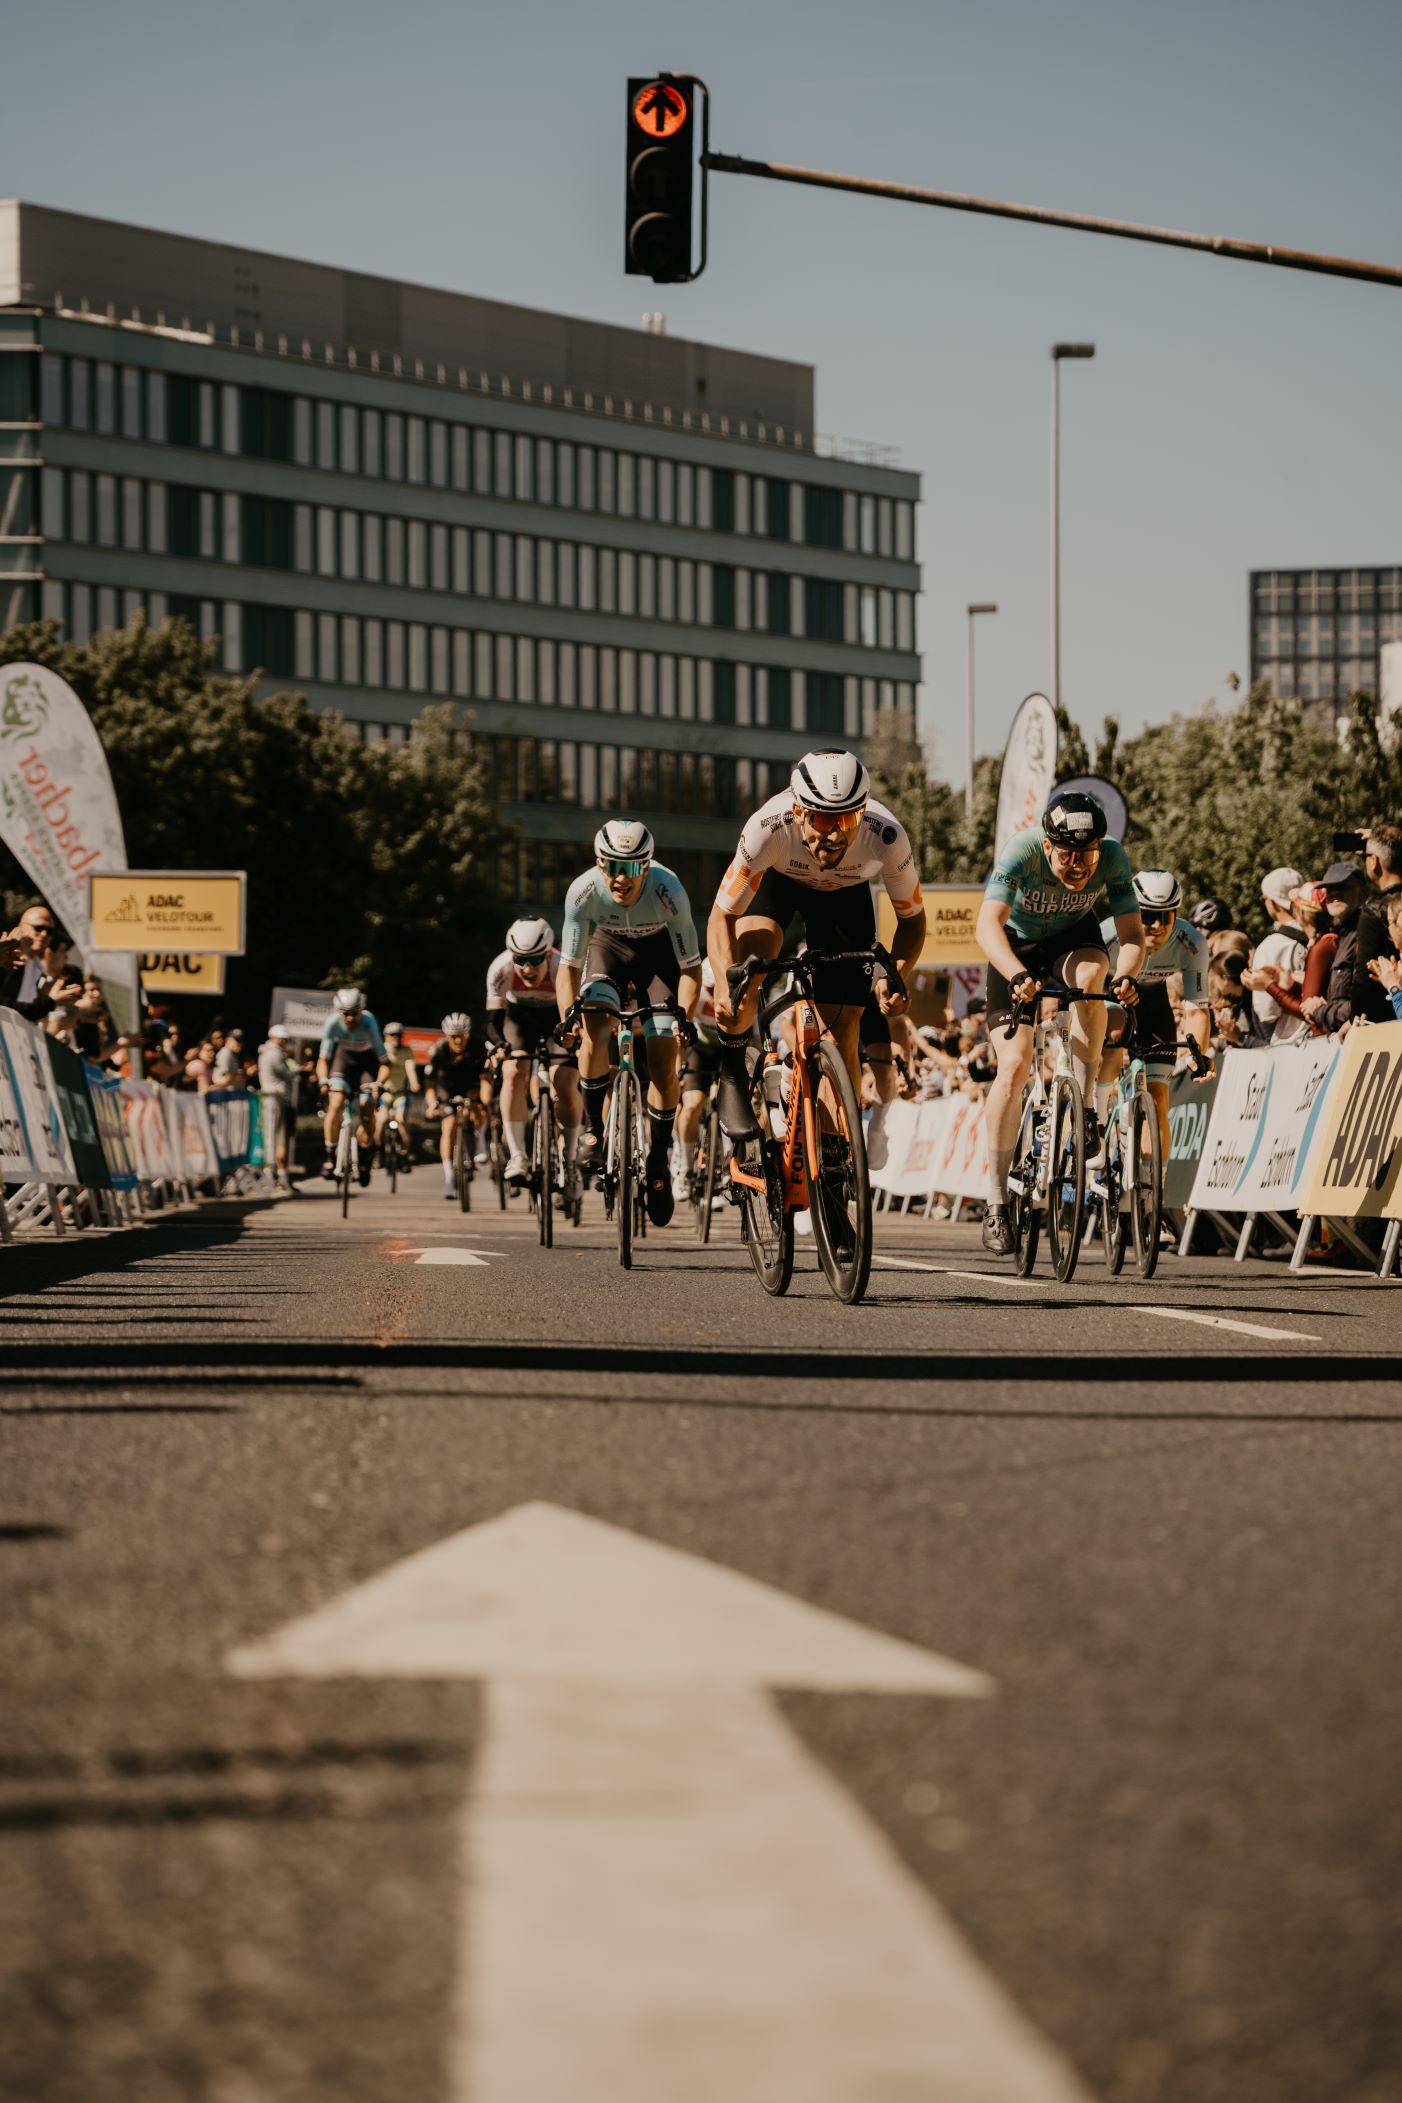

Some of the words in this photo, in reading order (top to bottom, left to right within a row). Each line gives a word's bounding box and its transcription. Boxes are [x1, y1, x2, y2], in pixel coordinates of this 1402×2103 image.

[789, 859, 809, 870] GOBIK
[147, 895, 184, 907] ADAC
[147, 912, 213, 922] VELOTOUR
[936, 909, 972, 921] ADAC
[936, 925, 976, 936] VELOT
[141, 953, 202, 974] DAC
[1168, 1102, 1207, 1161] ODA
